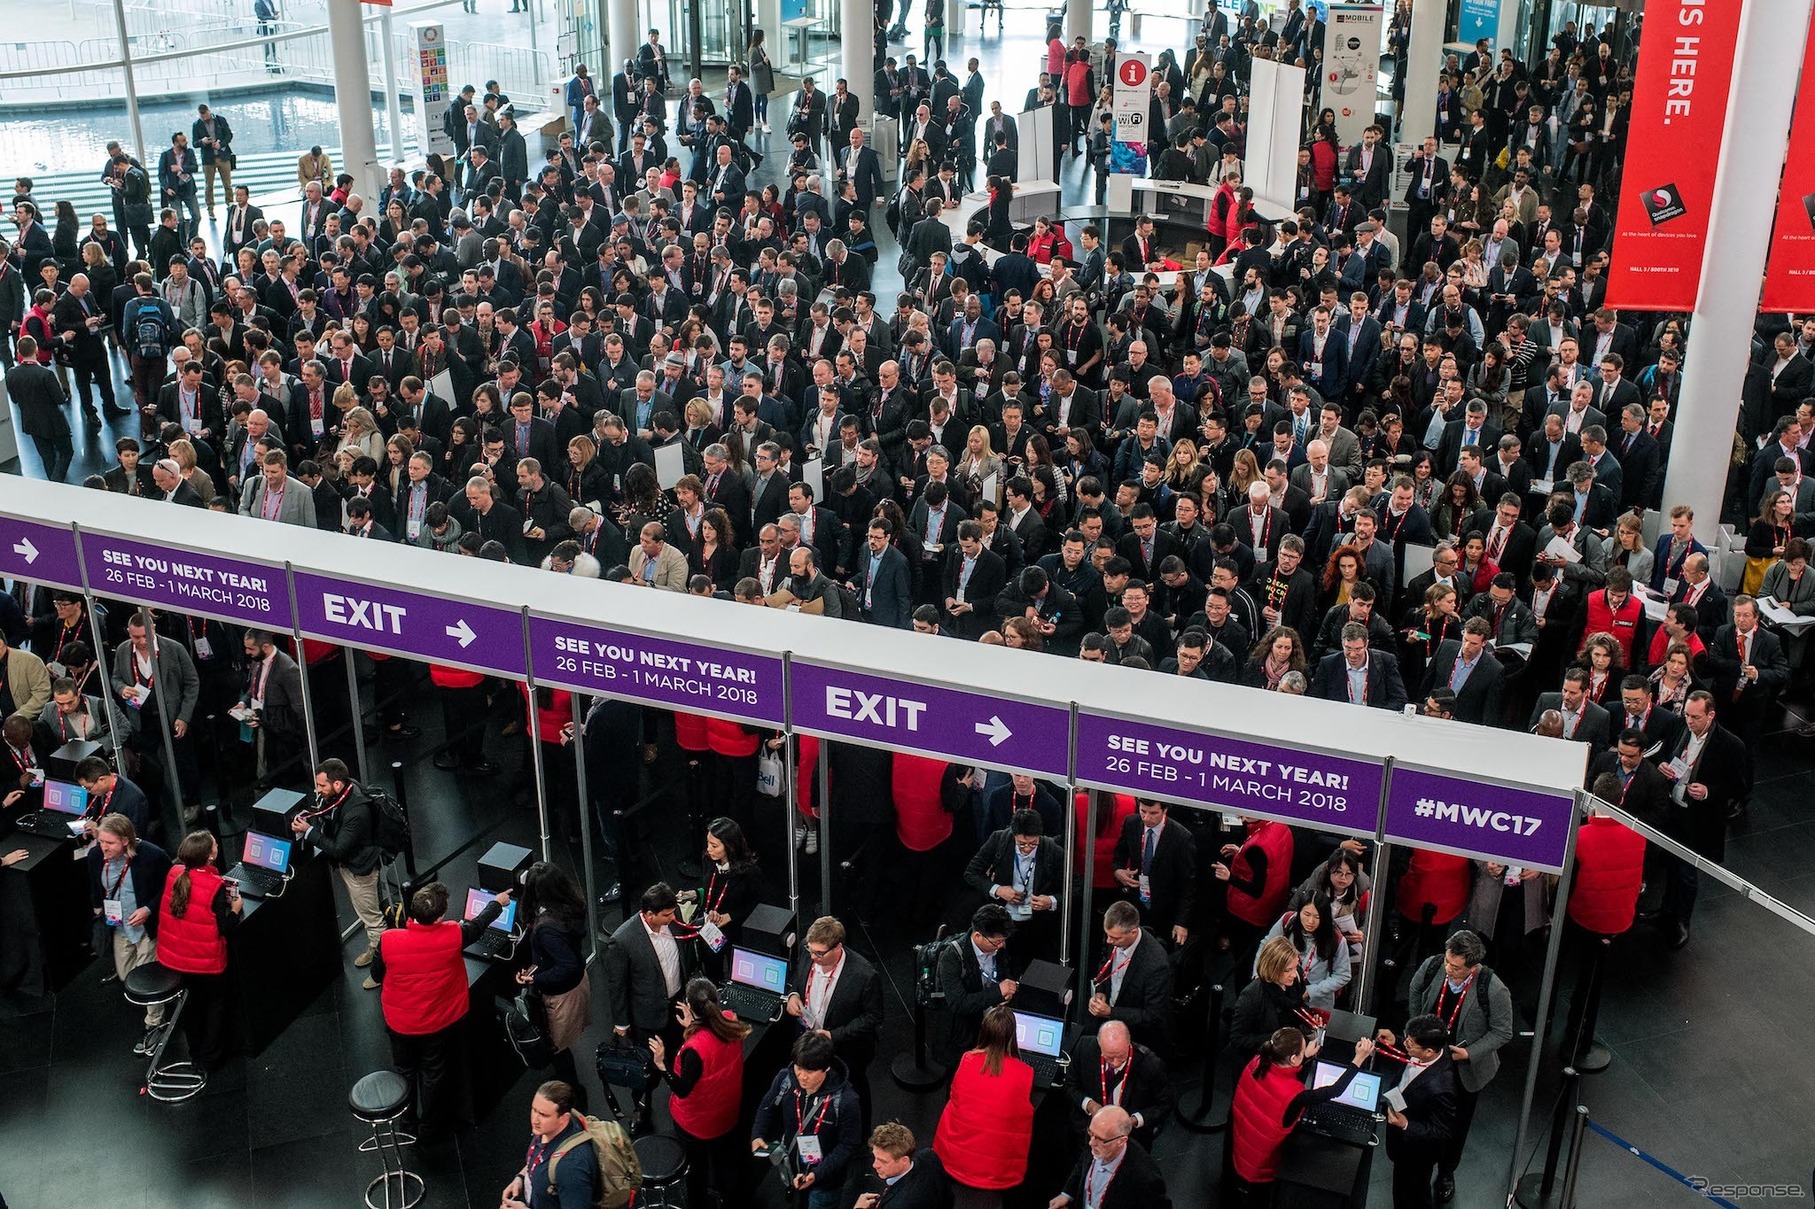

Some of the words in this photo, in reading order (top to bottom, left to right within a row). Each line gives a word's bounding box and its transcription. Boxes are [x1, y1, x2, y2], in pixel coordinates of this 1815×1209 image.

[1679, 0, 1705, 26] IS
[1663, 37, 1700, 125] HERE.
[103, 550, 132, 566] SEE
[134, 555, 168, 573] YOU
[172, 562, 213, 582] NEXT
[217, 571, 268, 592] YEAR!
[106, 568, 123, 583] 26
[127, 572, 155, 588] FEB
[168, 580, 174, 594] 1
[178, 581, 232, 604] MARCH
[237, 594, 271, 611] 2018
[323, 593, 406, 634] EXIT
[554, 636, 590, 655] SEE
[593, 643, 634, 662] YOU
[640, 651, 691, 673] NEXT
[696, 661, 756, 685] YEAR!
[556, 656, 576, 672] 26
[581, 661, 617, 679] FEB
[632, 669, 639, 684] 1
[645, 672, 711, 697] MARCH
[717, 685, 758, 704] 2018
[826, 686, 926, 731] EXIT
[758, 771, 775, 786] Bell
[1106, 756, 1130, 773] 26
[1137, 762, 1177, 782] FEB
[1198, 772, 1205, 787] 1
[1213, 775, 1291, 802] MARCH
[1298, 790, 1347, 811] 2018
[1107, 735, 1149, 755] SEE
[1156, 743, 1203, 764] YOU
[1210, 752, 1271, 777] NEXT
[1278, 763, 1350, 790] YEAR!
[1415, 798, 1542, 837] #MWC17
